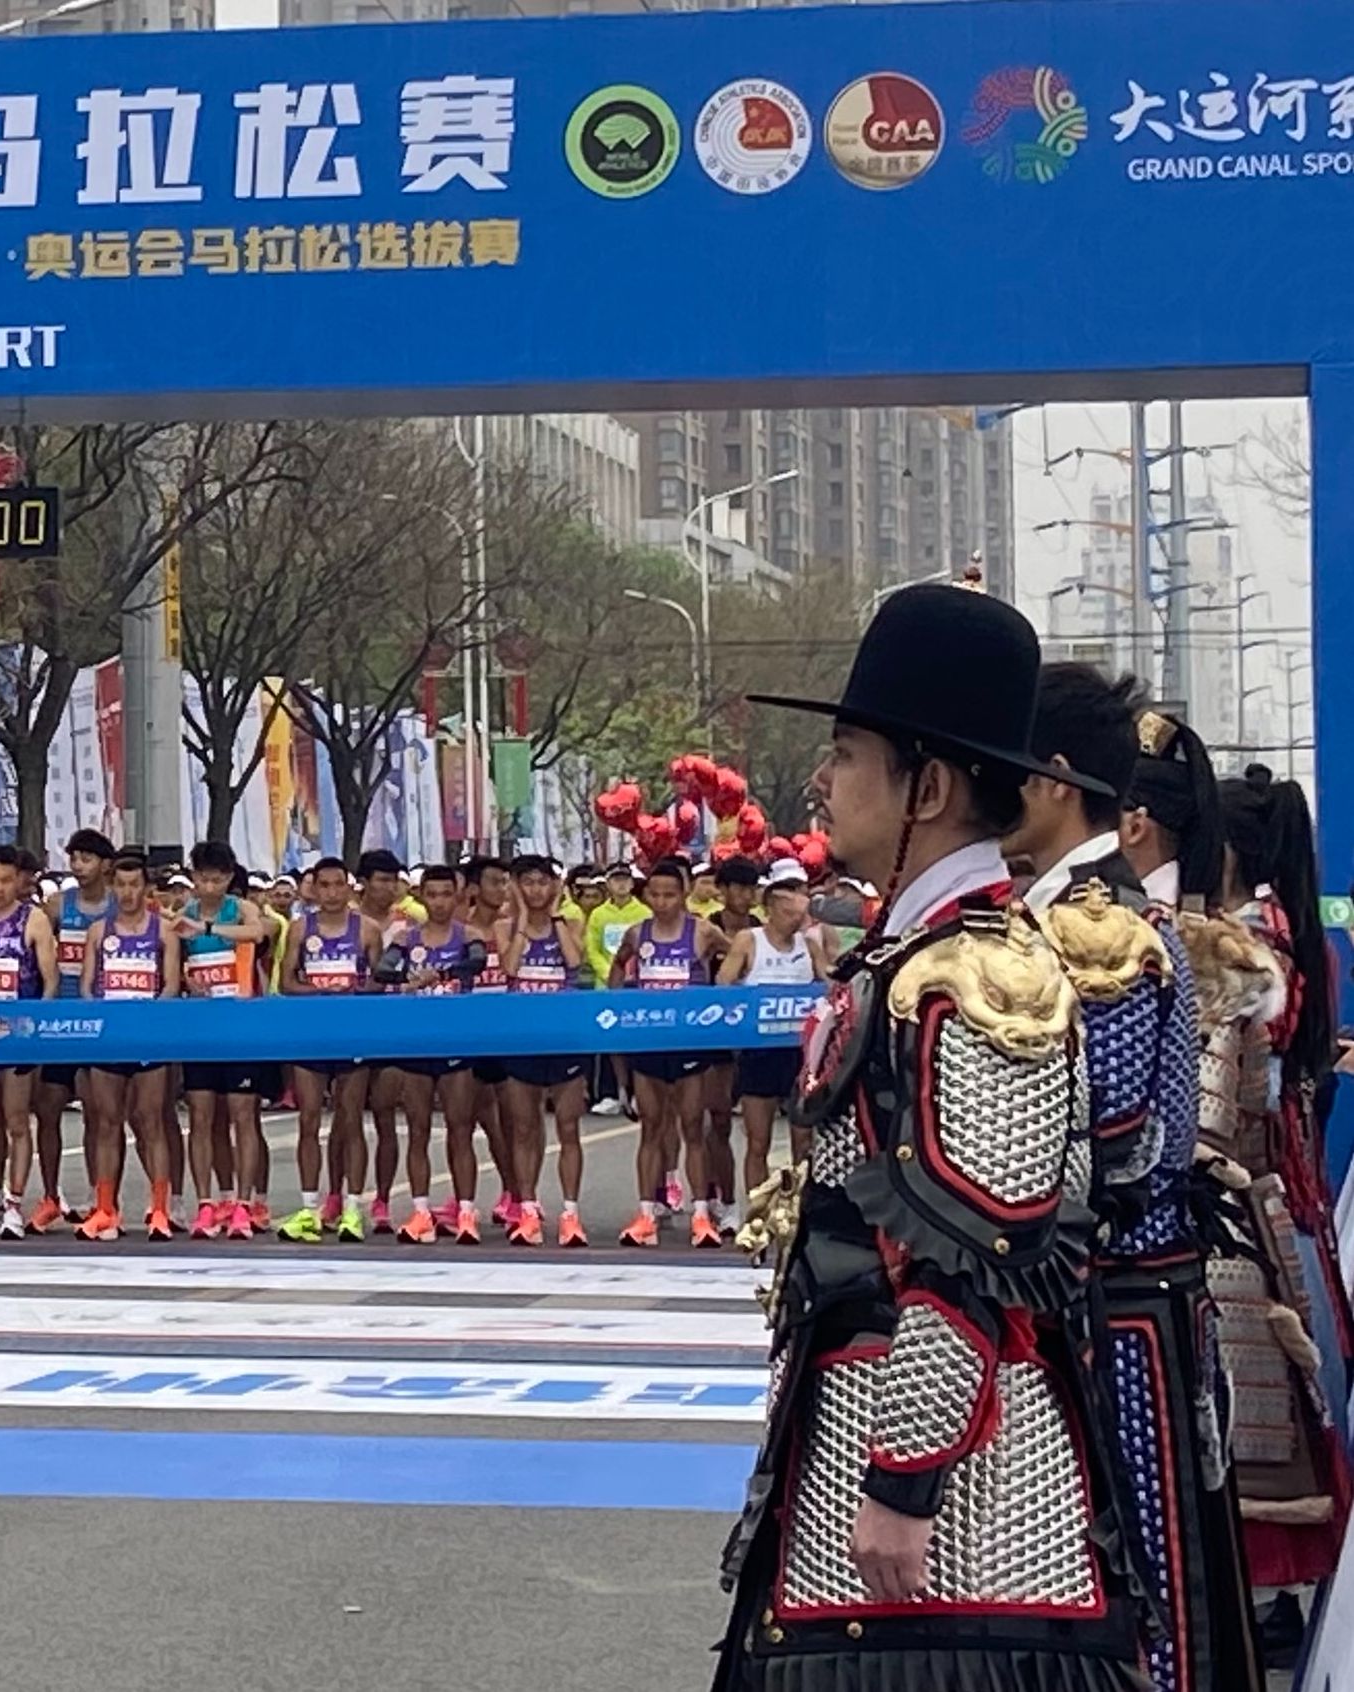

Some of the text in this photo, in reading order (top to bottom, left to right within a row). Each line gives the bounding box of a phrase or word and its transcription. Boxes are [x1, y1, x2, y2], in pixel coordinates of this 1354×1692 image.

[869, 118, 936, 143] CAA
[1127, 156, 1213, 181] GRAND
[1217, 154, 1298, 179] CANAL
